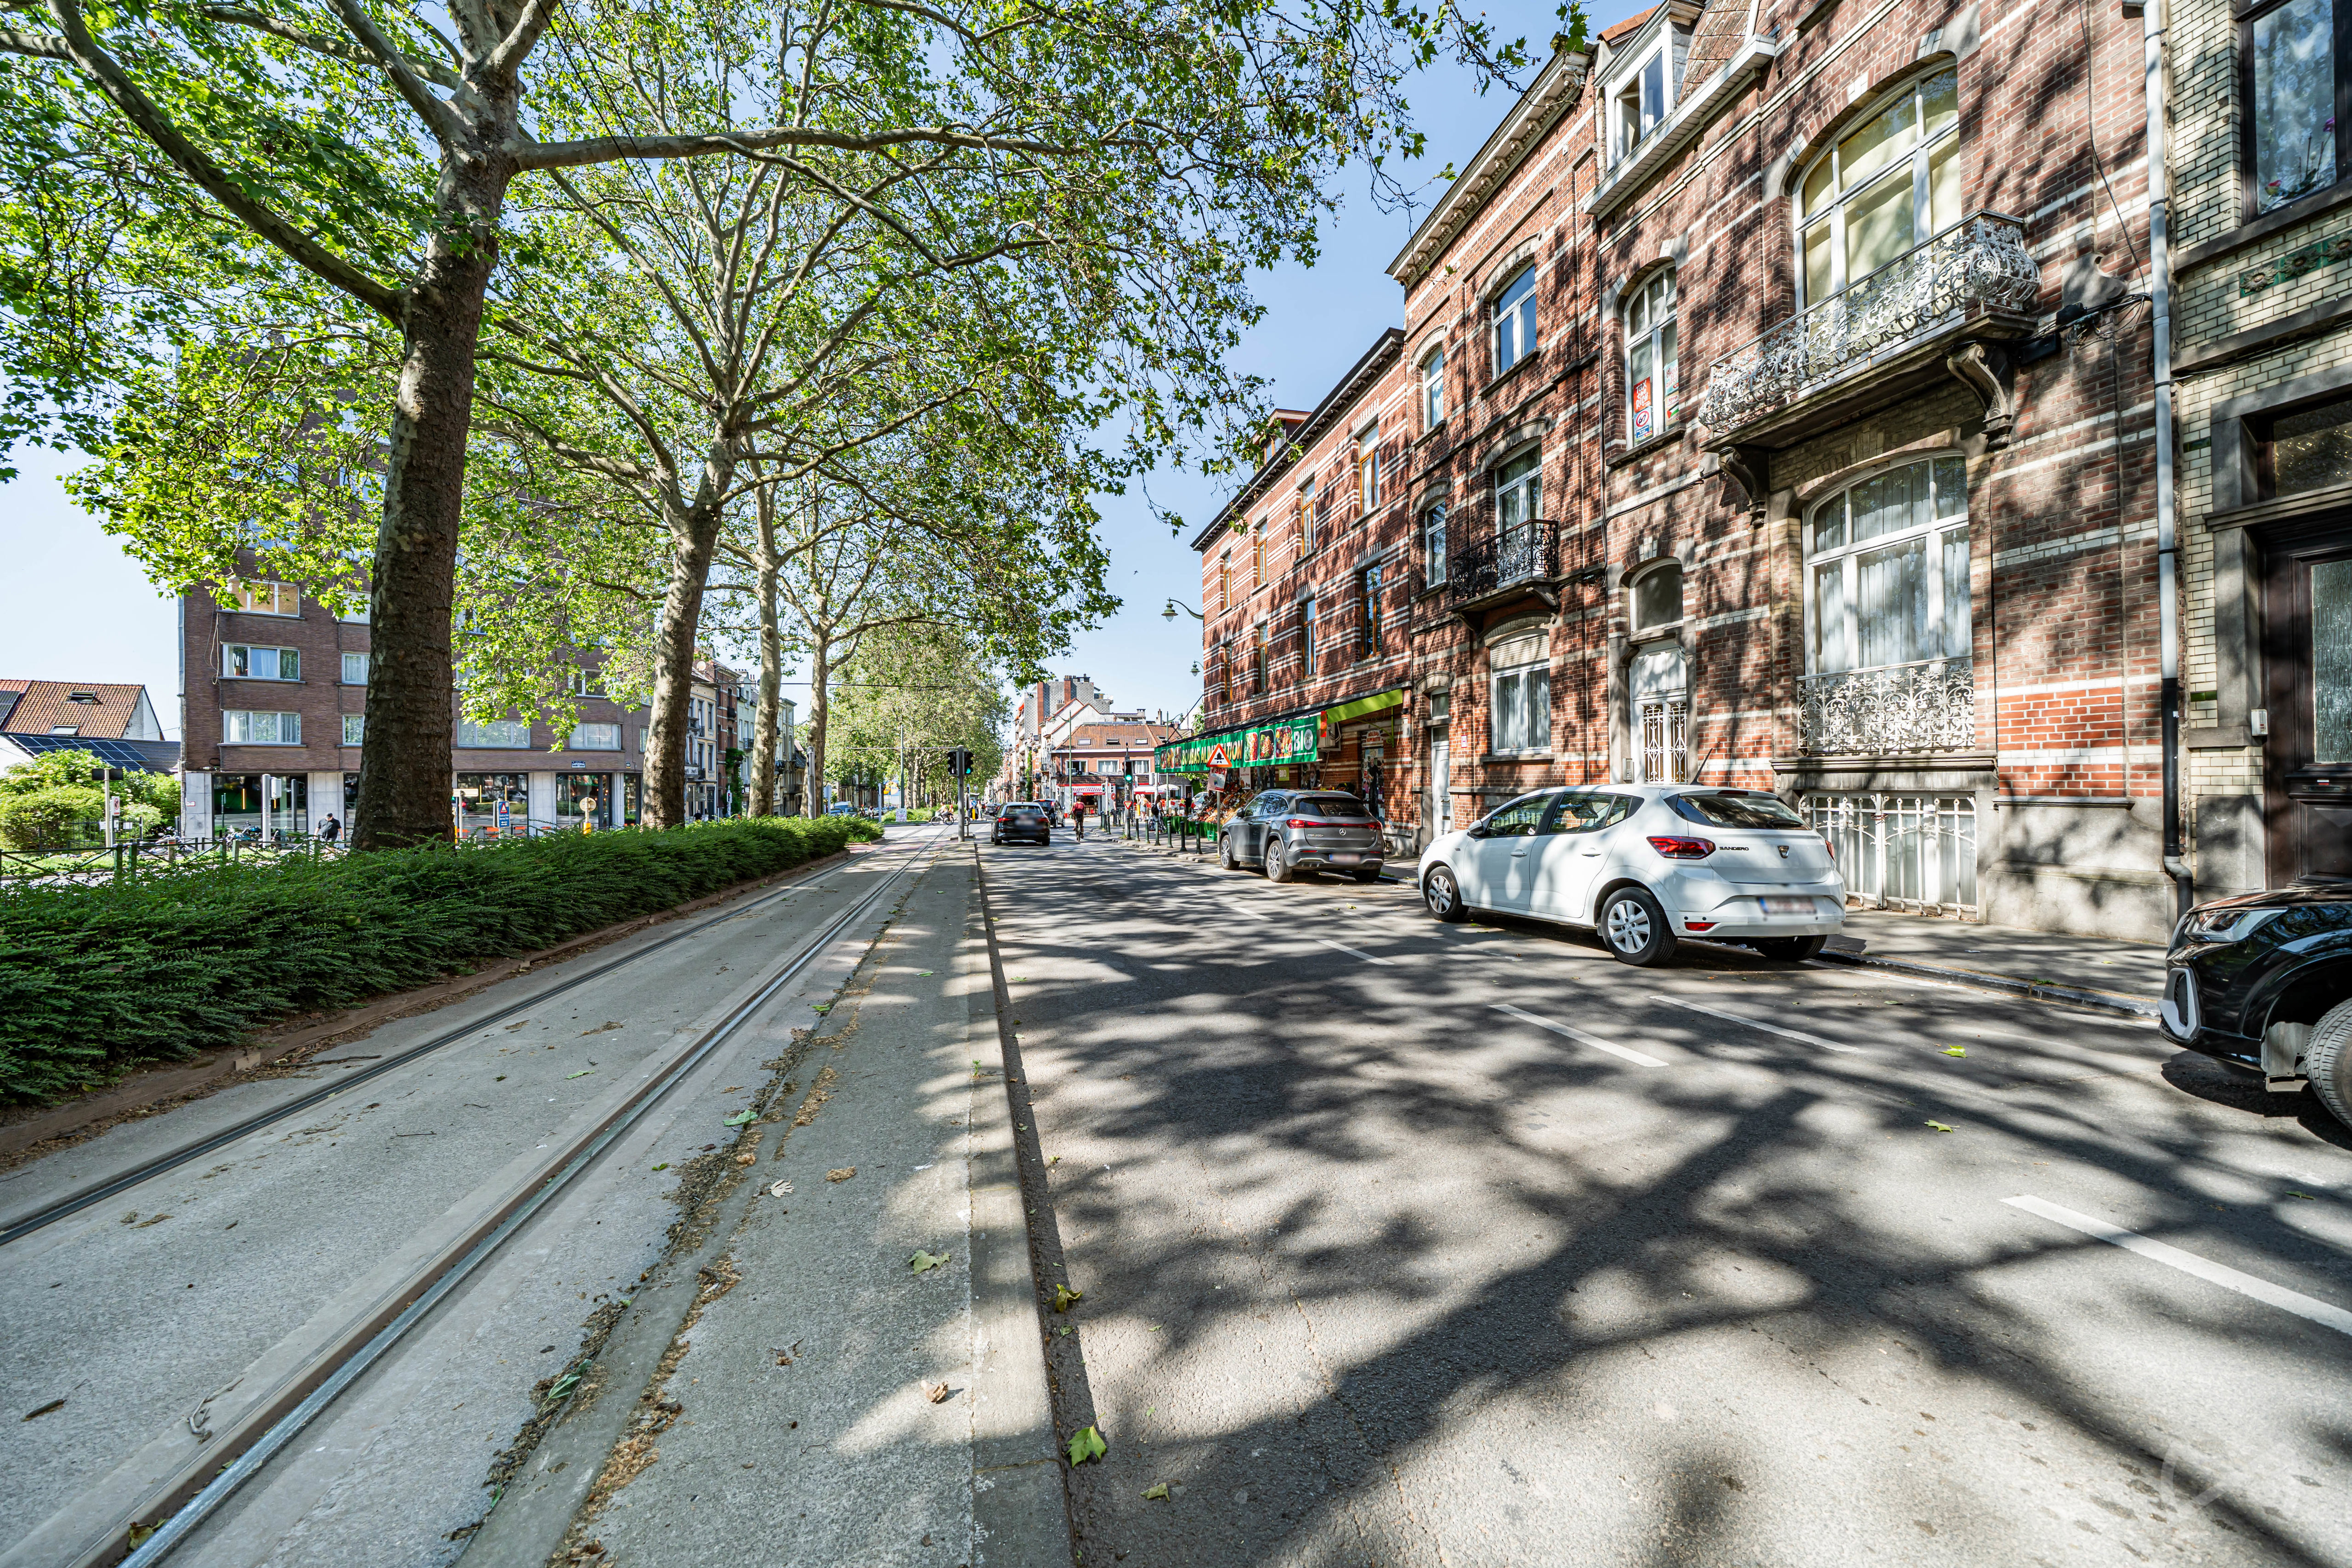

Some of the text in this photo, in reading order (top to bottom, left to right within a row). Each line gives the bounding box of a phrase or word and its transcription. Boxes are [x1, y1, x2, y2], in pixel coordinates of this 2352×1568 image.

[1637, 388, 1646, 399] the
[1639, 414, 1646, 424] 67
[1294, 729, 1313, 752] BIO
[1182, 747, 1200, 765] BOUBAS
